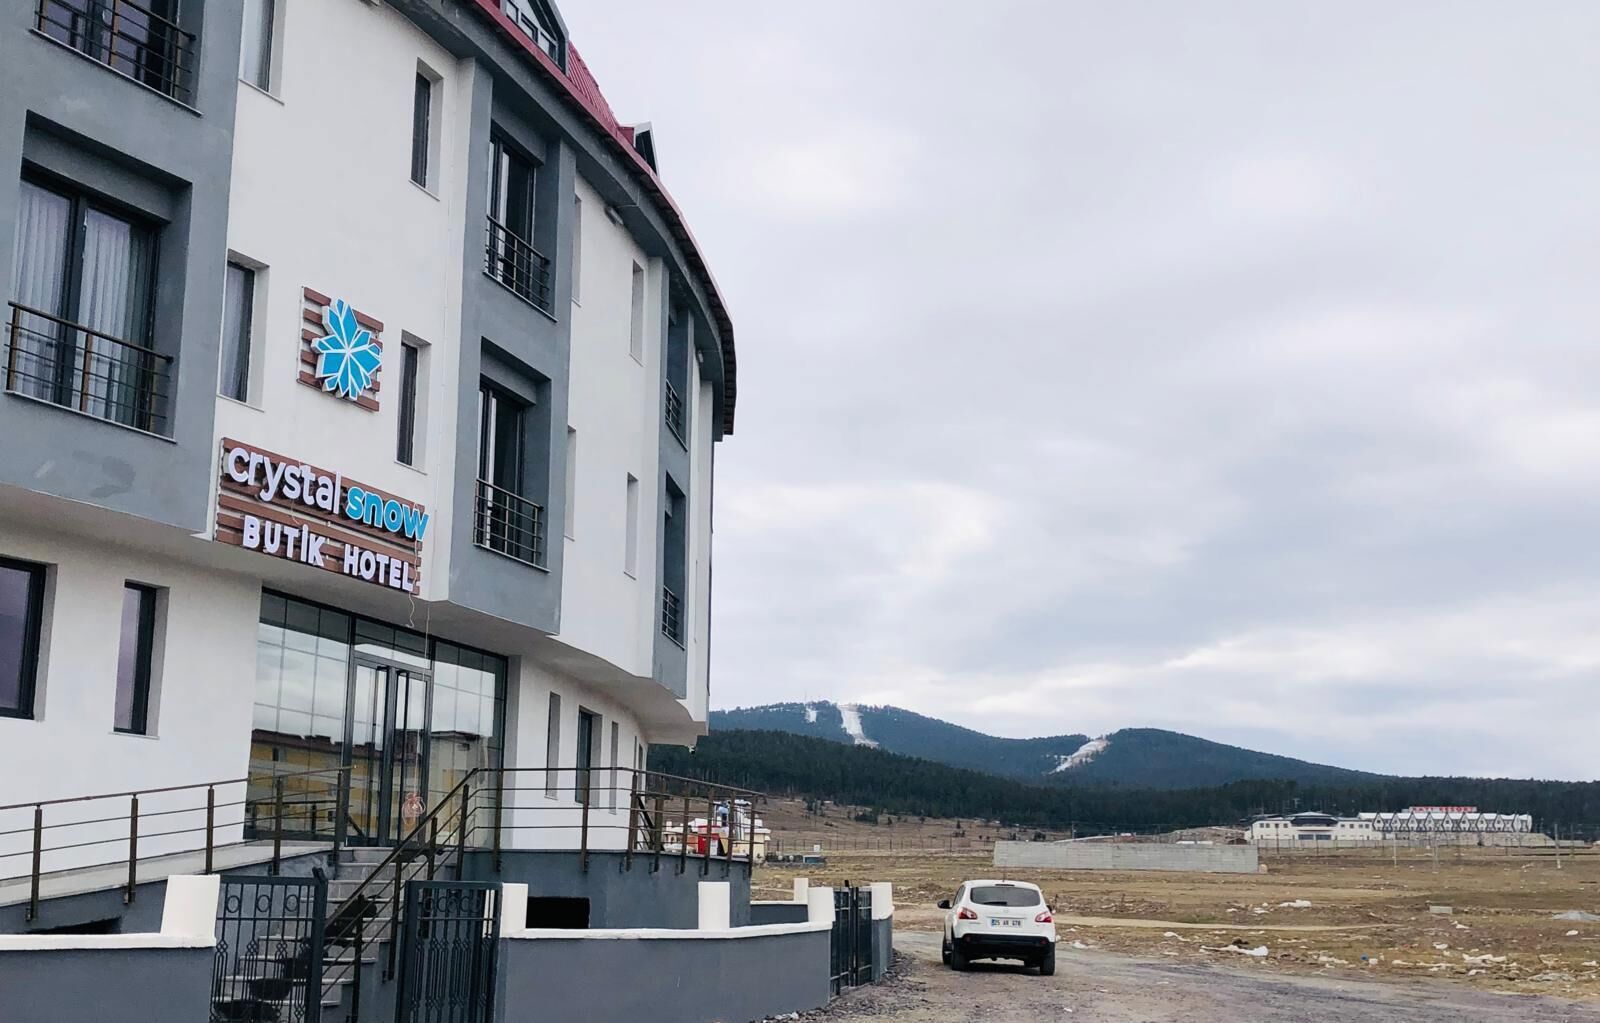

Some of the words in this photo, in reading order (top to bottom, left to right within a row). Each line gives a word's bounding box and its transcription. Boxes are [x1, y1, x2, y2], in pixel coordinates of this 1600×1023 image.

[228, 447, 342, 514] crystal
[346, 486, 430, 542] snow
[243, 515, 326, 567] BUTİK
[344, 543, 414, 592] HOTEL
